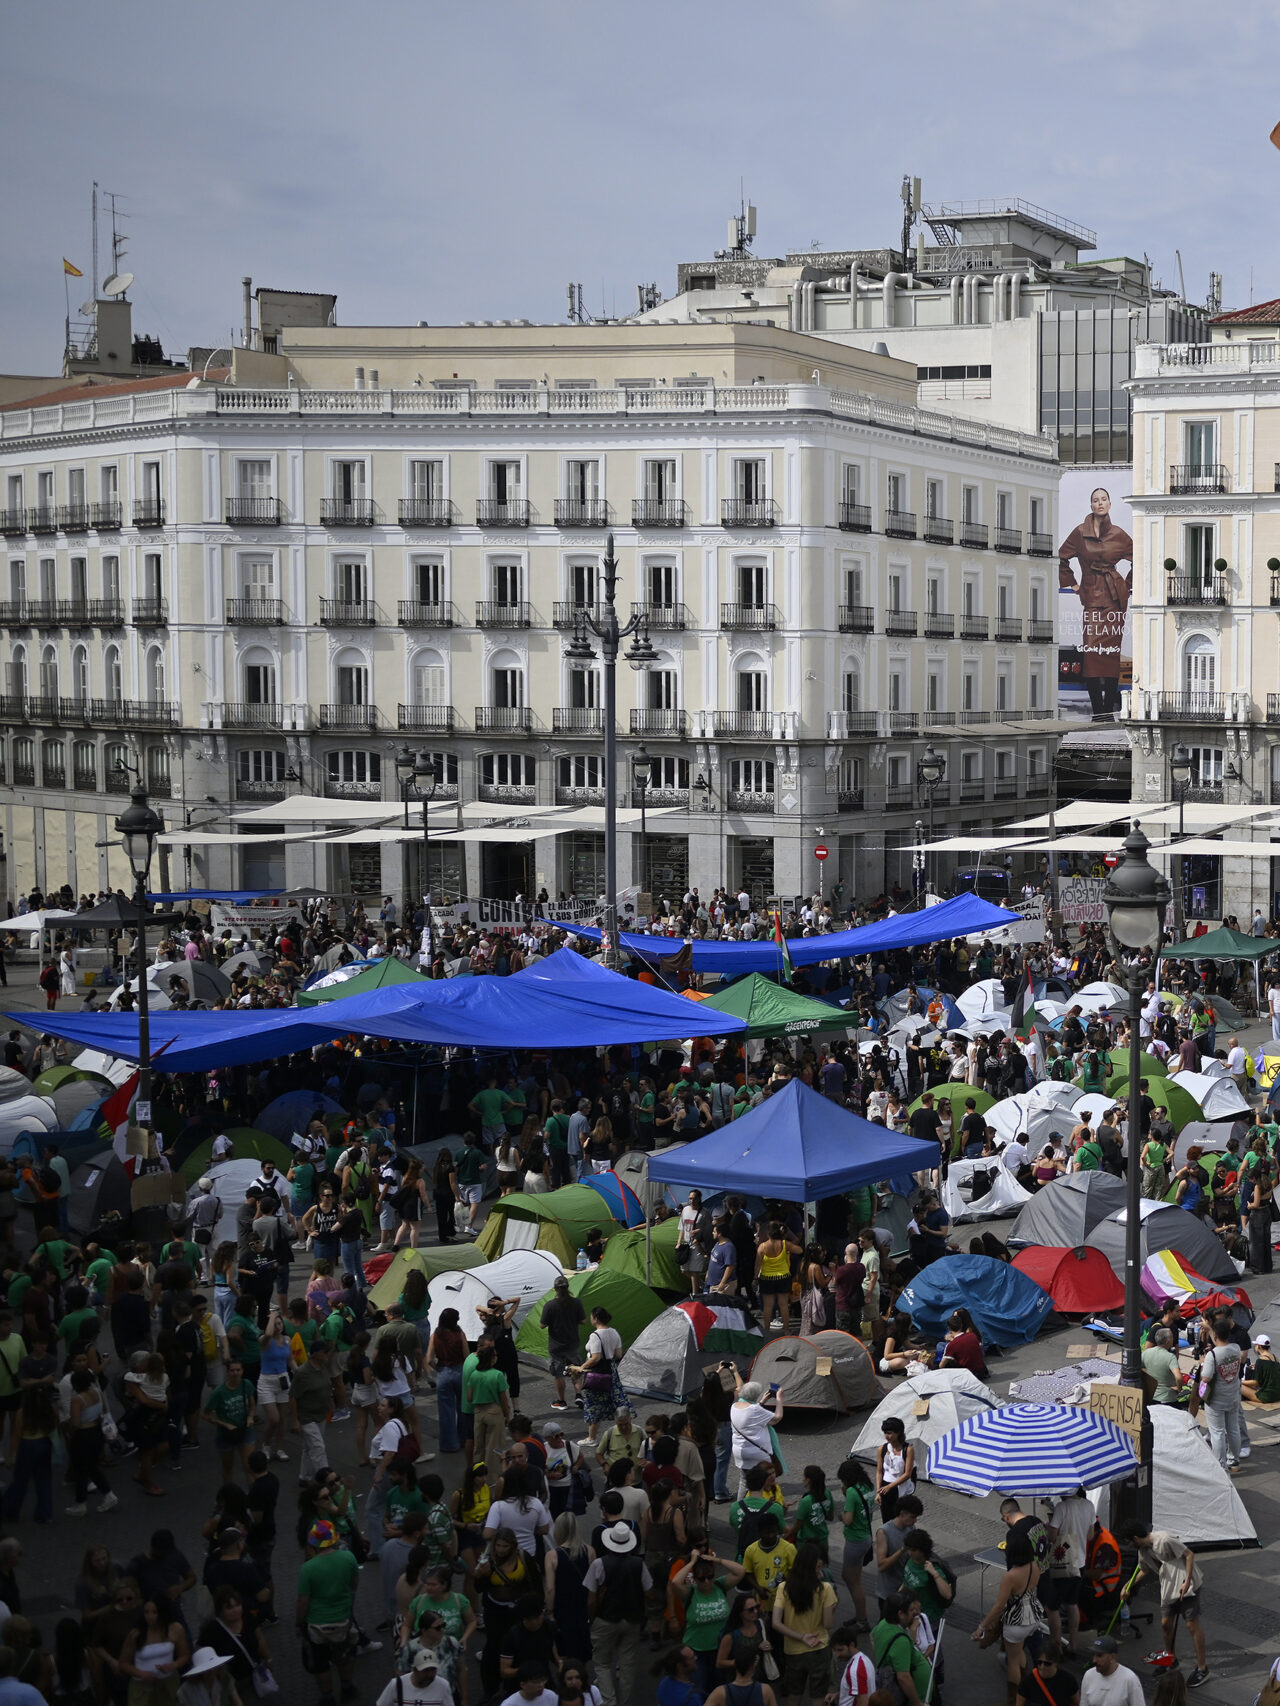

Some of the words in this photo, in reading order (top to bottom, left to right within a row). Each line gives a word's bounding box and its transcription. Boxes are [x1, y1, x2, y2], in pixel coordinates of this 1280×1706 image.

[1092, 611, 1104, 622] EL
[1095, 625, 1109, 636] LA
[1090, 1392, 1142, 1425] PRENSA
